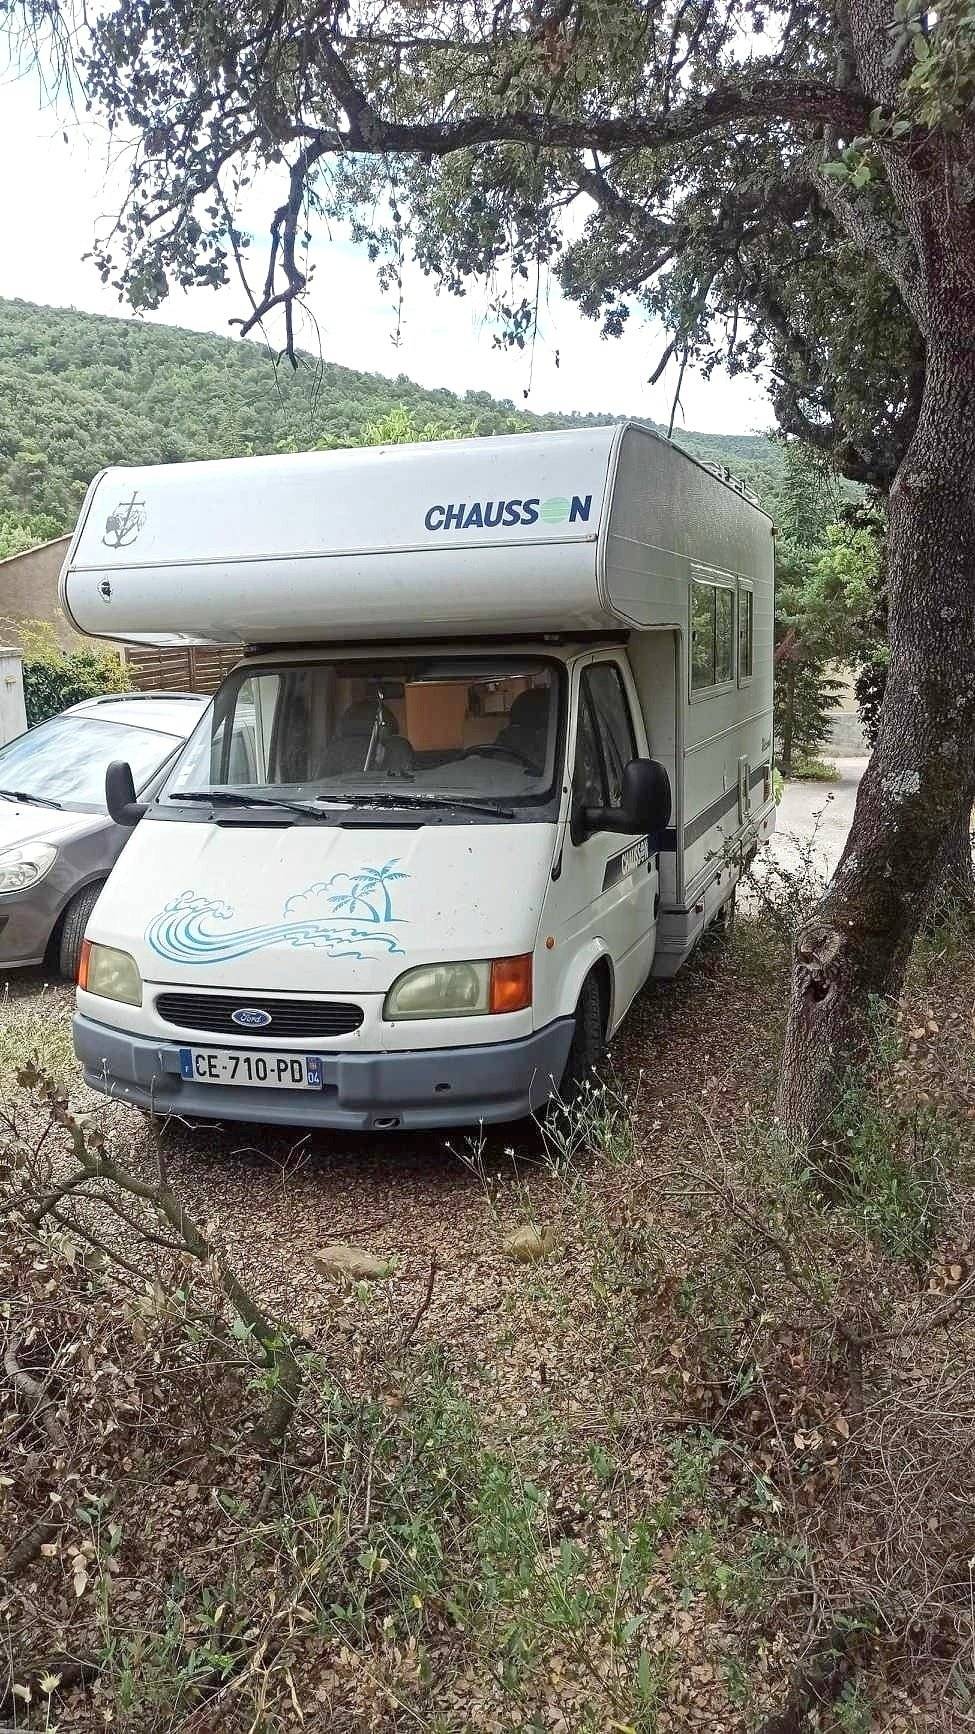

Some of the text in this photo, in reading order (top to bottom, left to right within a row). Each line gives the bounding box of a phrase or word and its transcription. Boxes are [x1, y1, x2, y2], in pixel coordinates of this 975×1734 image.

[424, 495, 592, 531] CHAUSSON
[239, 1012, 263, 1024] Ford
[195, 1054, 304, 1083] CE-710-PD
[307, 1071, 321, 1084] 04
